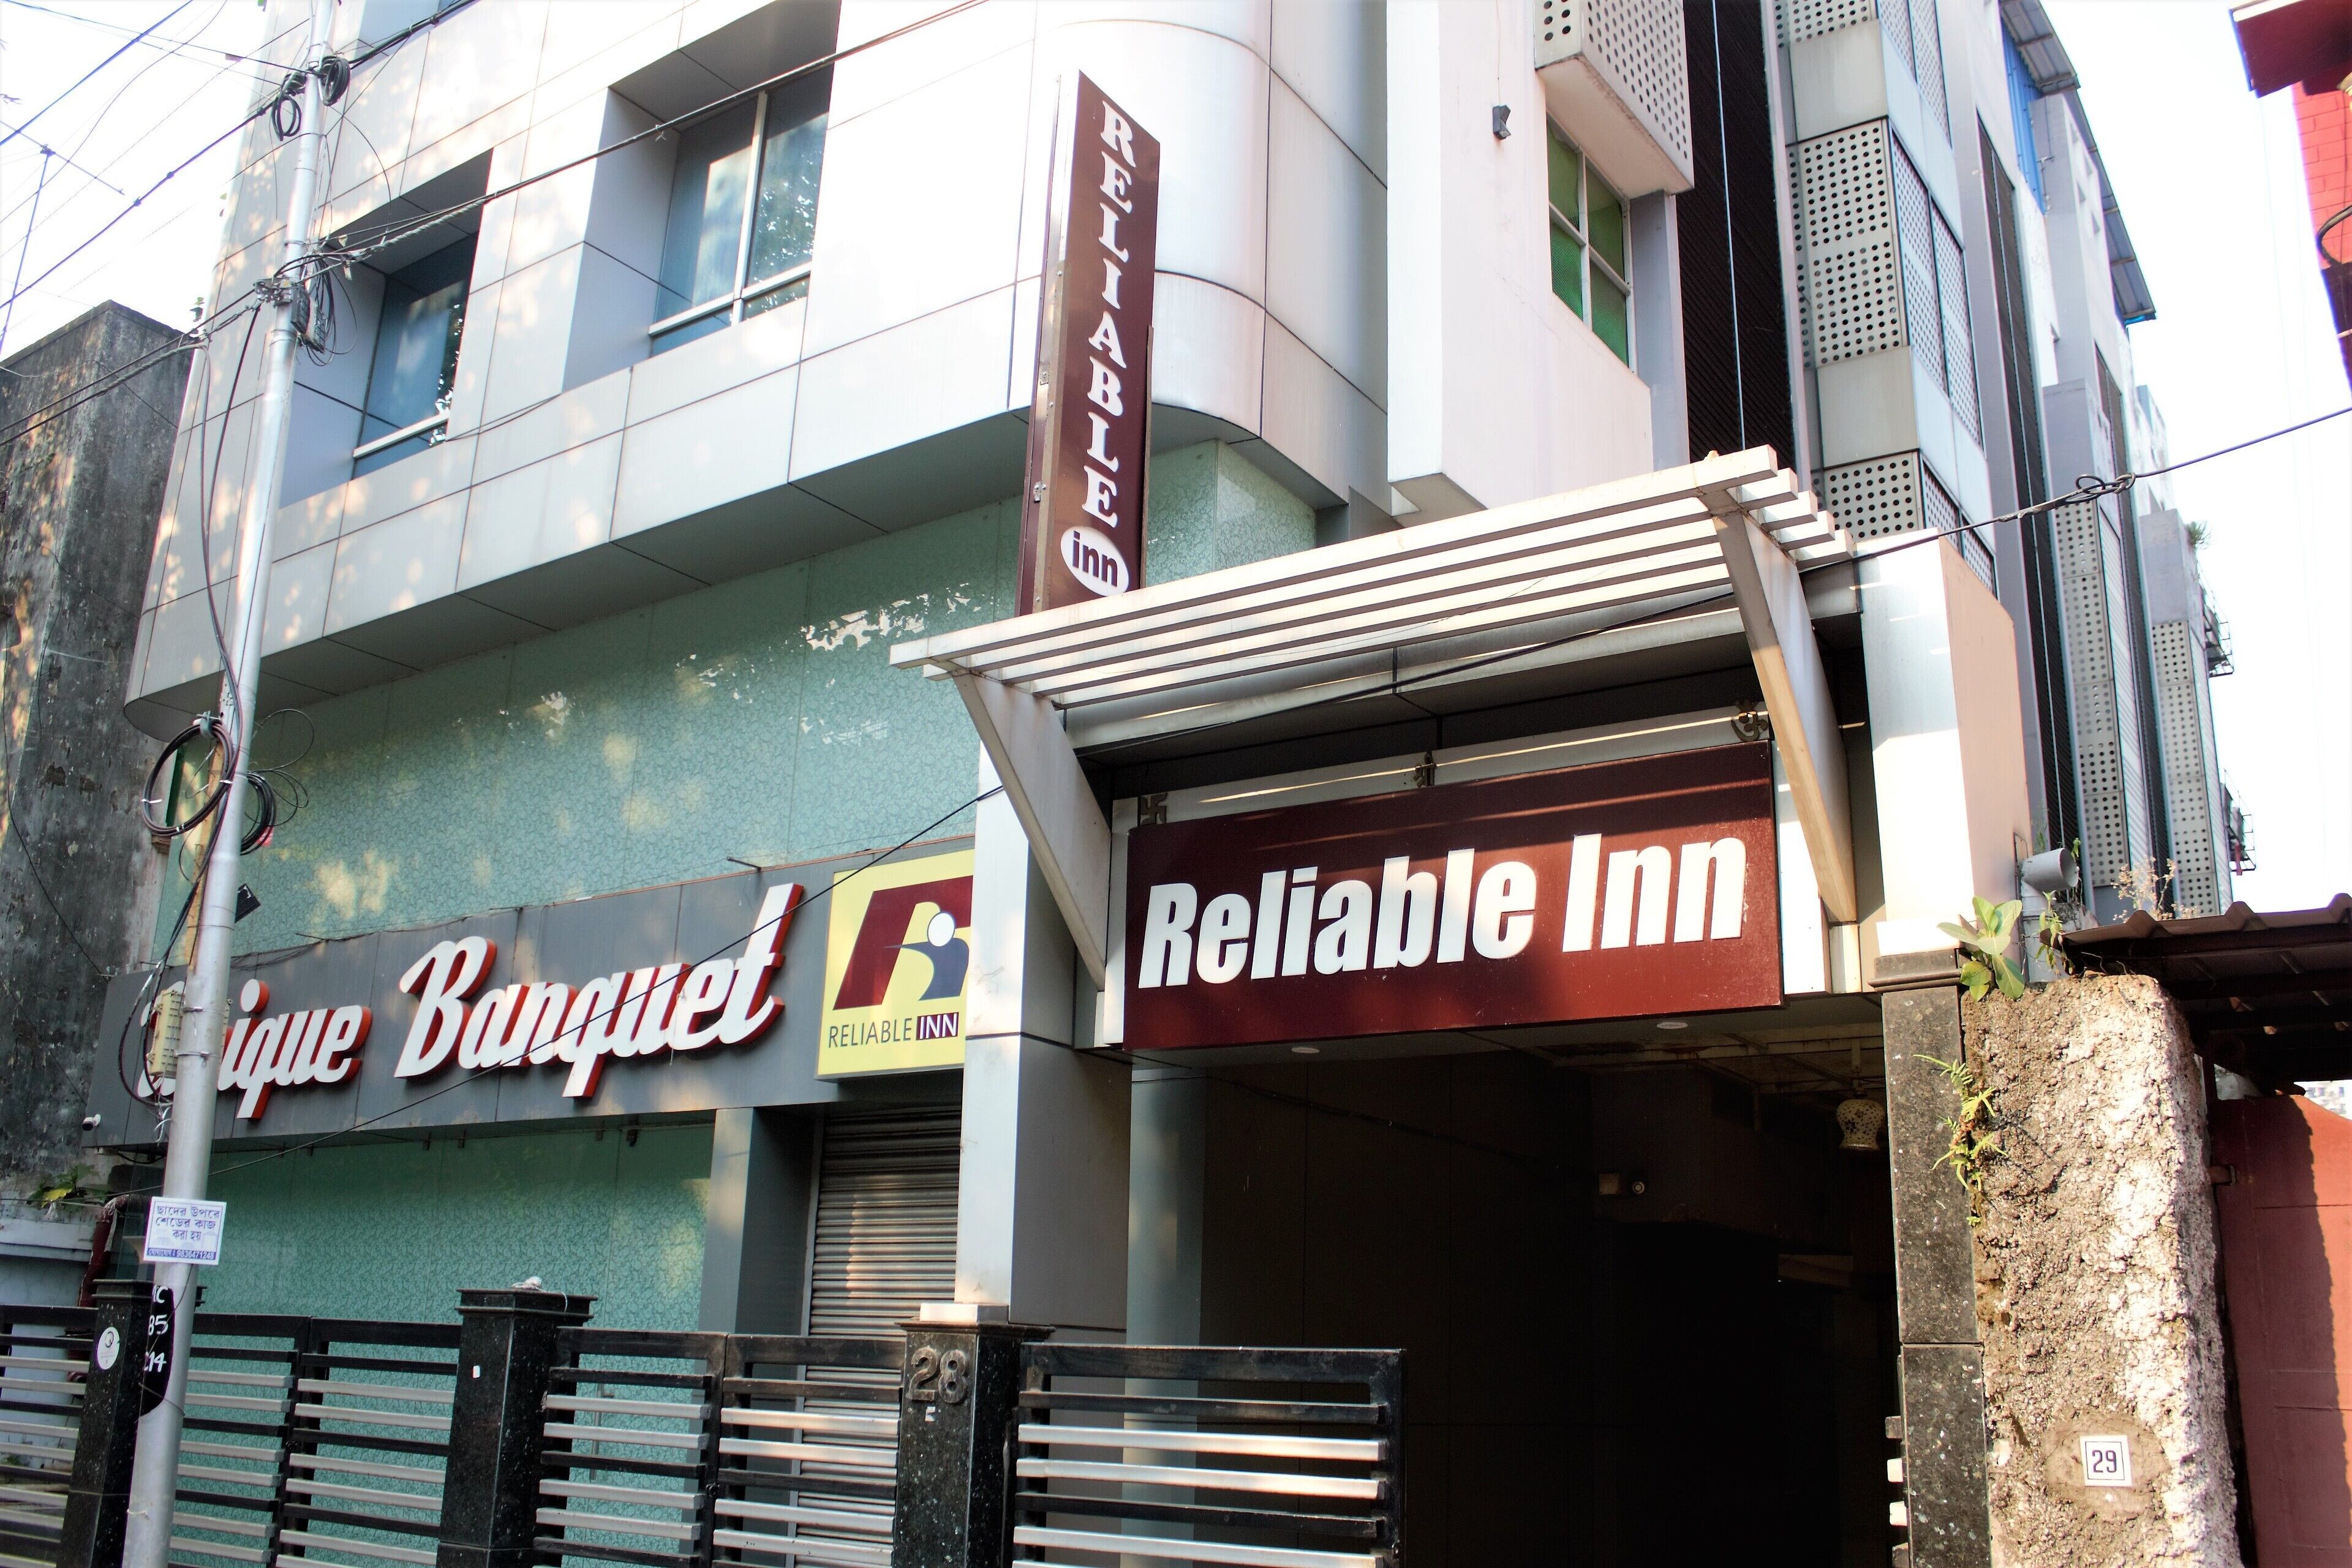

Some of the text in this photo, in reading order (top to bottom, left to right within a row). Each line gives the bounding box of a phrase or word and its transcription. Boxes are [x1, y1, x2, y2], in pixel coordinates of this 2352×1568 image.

[1081, 99, 1137, 529] RELIABLE
[1072, 530, 1118, 588] inn
[1138, 833, 1747, 989] Reliable Inn
[394, 882, 804, 1098] Banquet
[828, 1012, 958, 1048] RELIABLE INN
[905, 1347, 968, 1404] 28
[2091, 1449, 2117, 1474] 29
